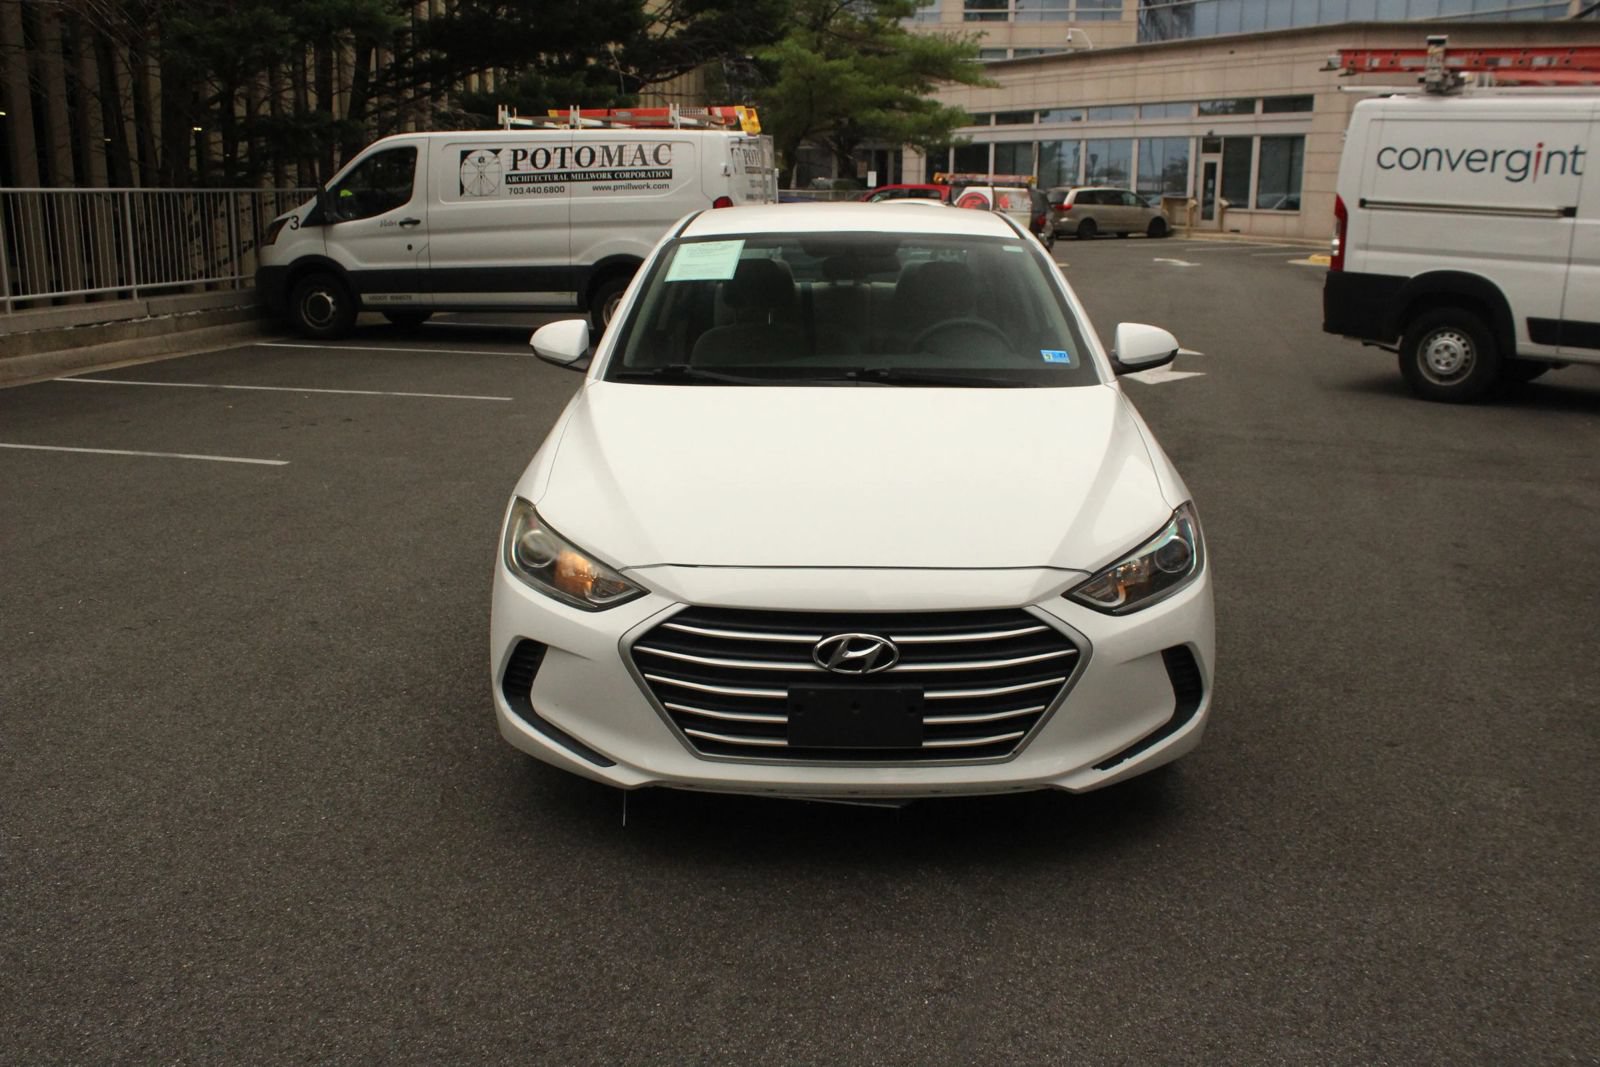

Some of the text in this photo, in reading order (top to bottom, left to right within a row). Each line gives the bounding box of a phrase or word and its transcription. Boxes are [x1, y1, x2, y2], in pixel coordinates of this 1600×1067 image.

[510, 143, 672, 171] POTOMAC
[1377, 142, 1587, 183] convergint
[507, 170, 671, 183] ARCHITECTURAL MILLWORK CORPORATION
[508, 186, 565, 195] 703.440.6800
[592, 182, 670, 191] www.pmillwork.com
[290, 216, 300, 230] 3
